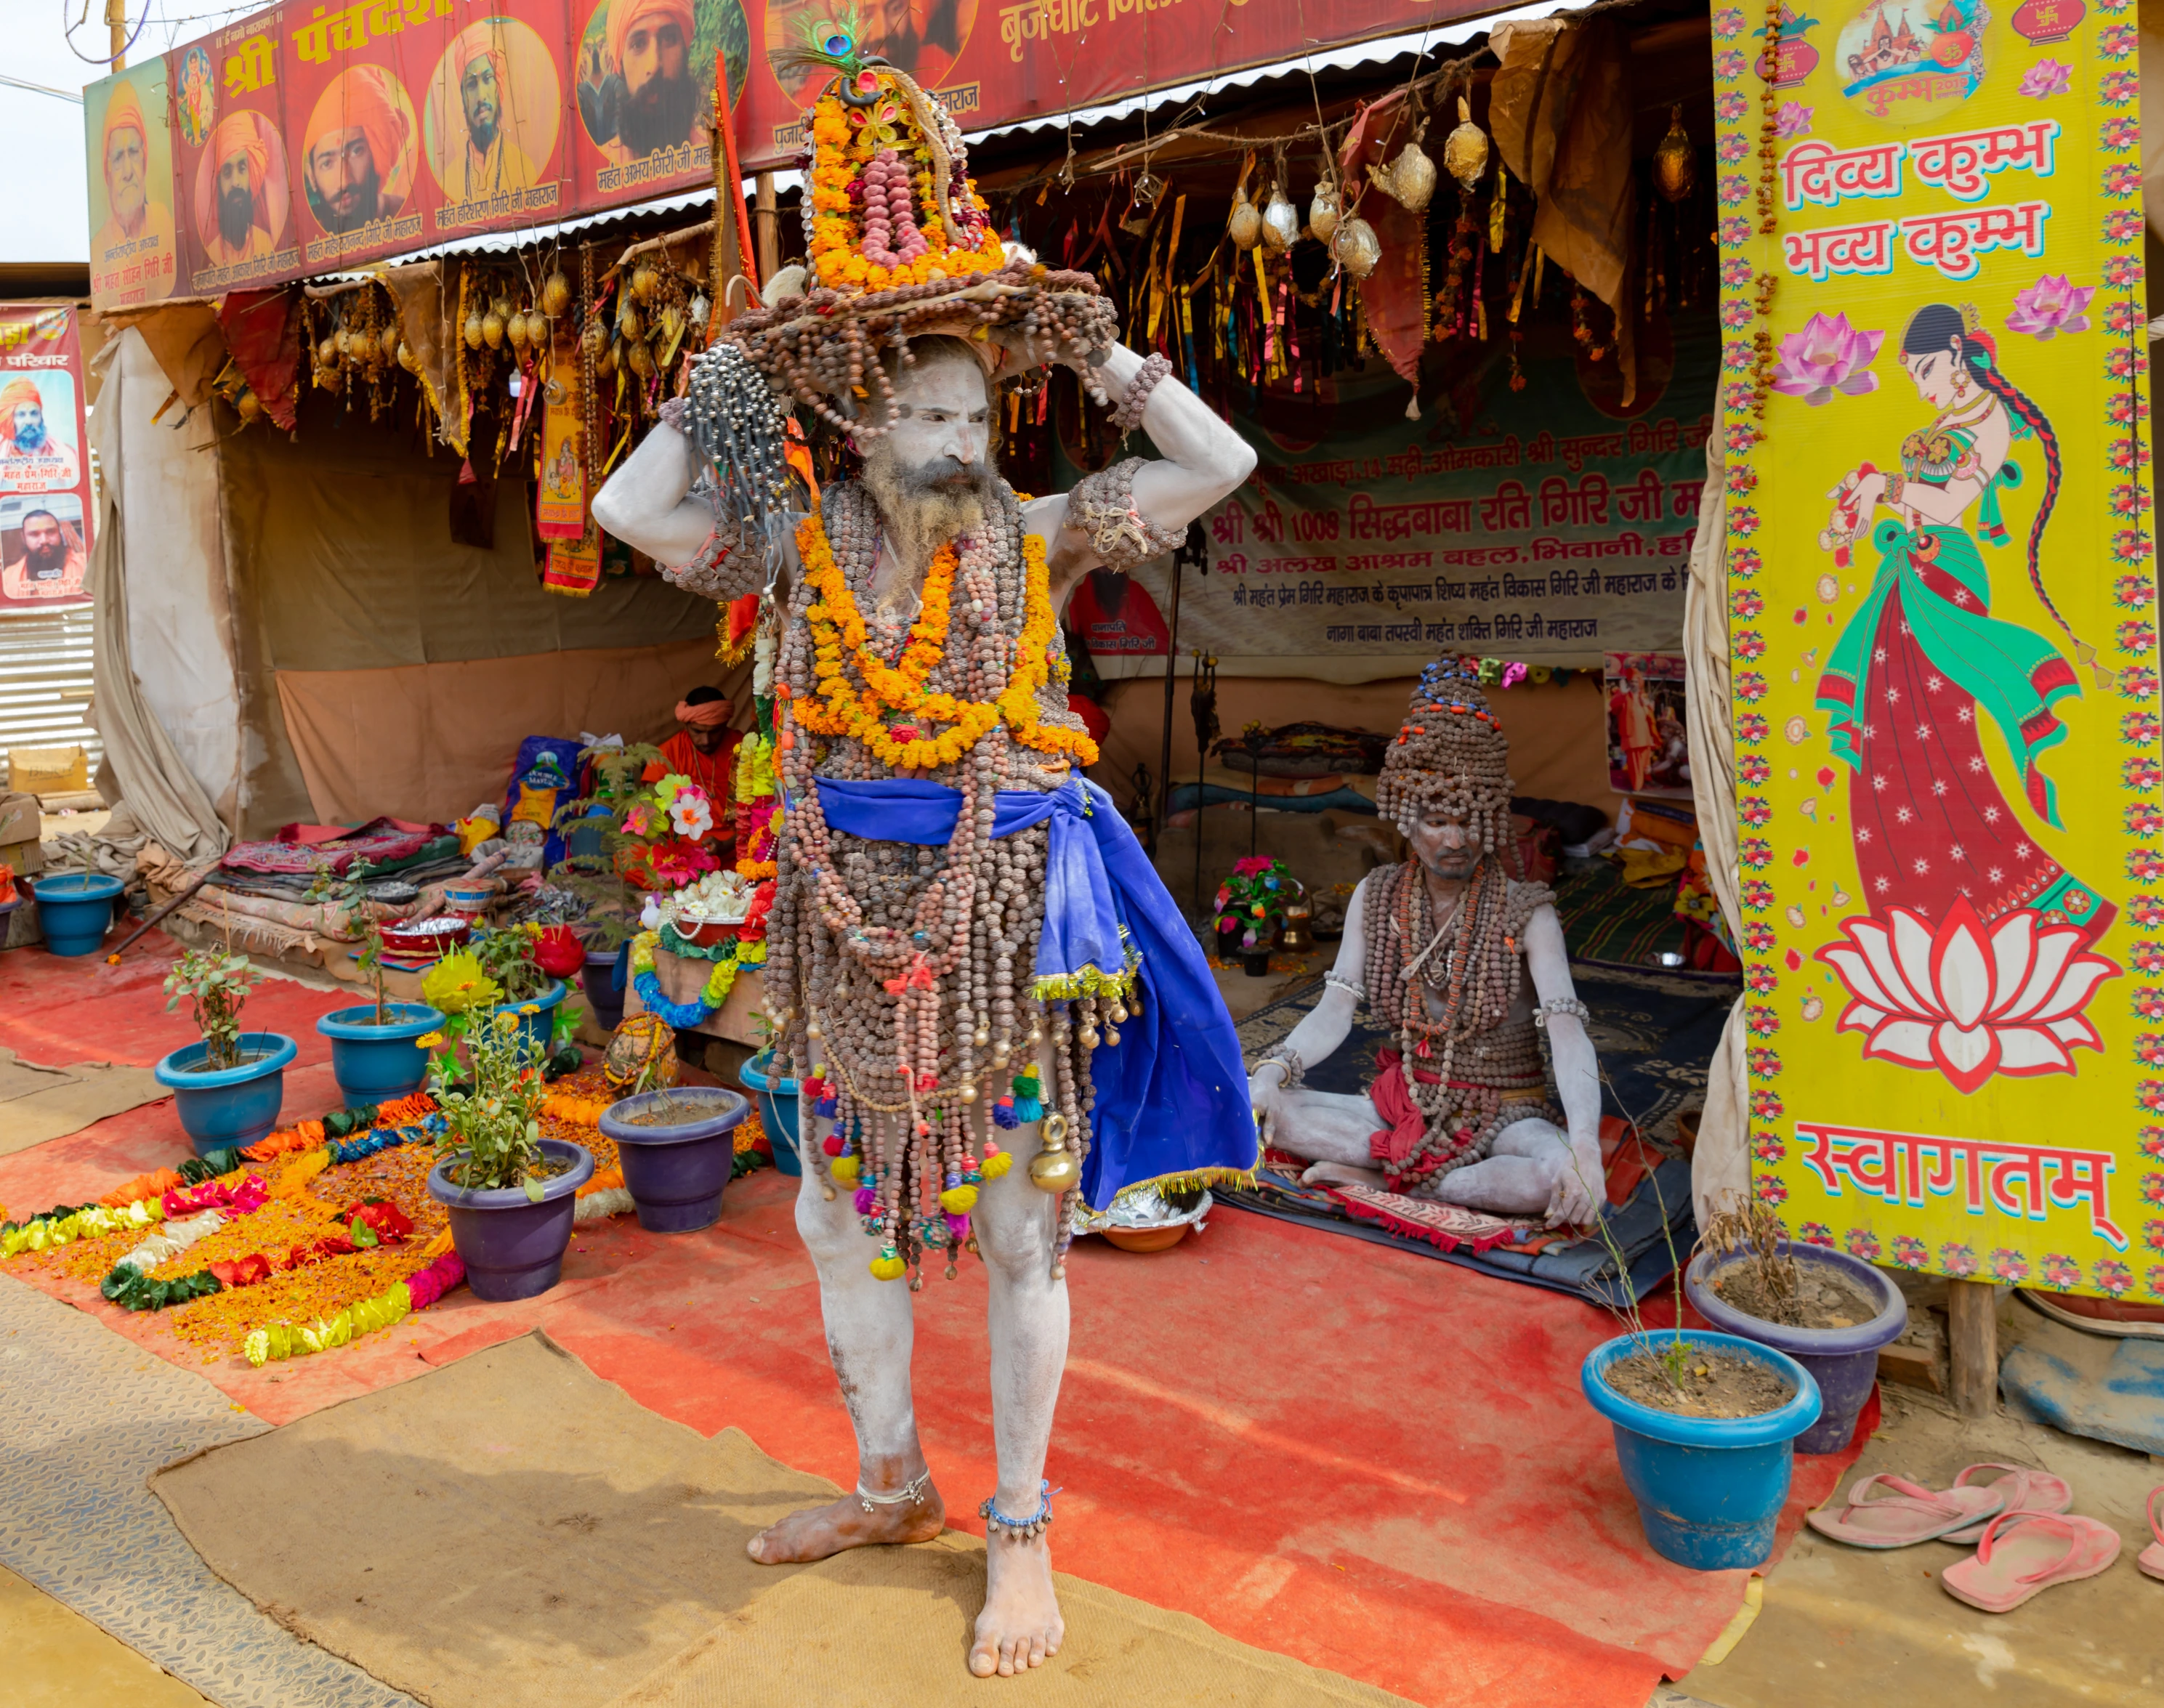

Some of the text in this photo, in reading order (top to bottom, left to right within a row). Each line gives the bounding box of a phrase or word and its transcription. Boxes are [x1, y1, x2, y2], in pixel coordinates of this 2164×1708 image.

[223, 34, 278, 98] श्री
[1936, 77, 1969, 92] 2019
[624, 161, 649, 184] अभय
[677, 144, 690, 169] जी
[1780, 122, 2055, 206] दिव्य कुम्भ
[525, 185, 557, 211] महाराज
[394, 216, 422, 239] महाराज
[1785, 203, 2046, 277] भव्य कुम्भ
[1526, 430, 1555, 464] श्री
[1559, 432, 1625, 473] सुन्दर
[1627, 418, 1679, 456] गिरि
[1211, 500, 1245, 545] श्री
[1251, 498, 1284, 543] श्री
[1291, 510, 1341, 543] 1008
[1479, 478, 1532, 533] रति
[1538, 473, 1611, 527] गिरि
[1615, 468, 1664, 522] जी
[1216, 553, 1248, 574] श्री
[1256, 556, 1338, 574] अलख
[1345, 551, 1434, 572] आश्रम
[1233, 582, 1247, 607] श्री
[1249, 583, 1275, 608] महंत
[1278, 583, 1296, 609] प्रेम
[1299, 580, 1323, 605] गिरि
[1326, 586, 1370, 607] महाराज
[1371, 580, 1385, 604] के
[1436, 575, 1466, 602] शिष्य
[1469, 575, 1501, 602] महंत
[1503, 572, 1546, 599] विकास
[1550, 570, 1579, 597] गिरि
[1581, 567, 1601, 595] जी
[1604, 572, 1658, 596] महाराज
[1661, 565, 1676, 593] के
[1426, 617, 1455, 644] महंत
[1495, 613, 1522, 640] गिरि
[1525, 612, 1543, 639] जी
[1547, 618, 1598, 641] महाराज
[1796, 1122, 2128, 1247] स्वागतम्
